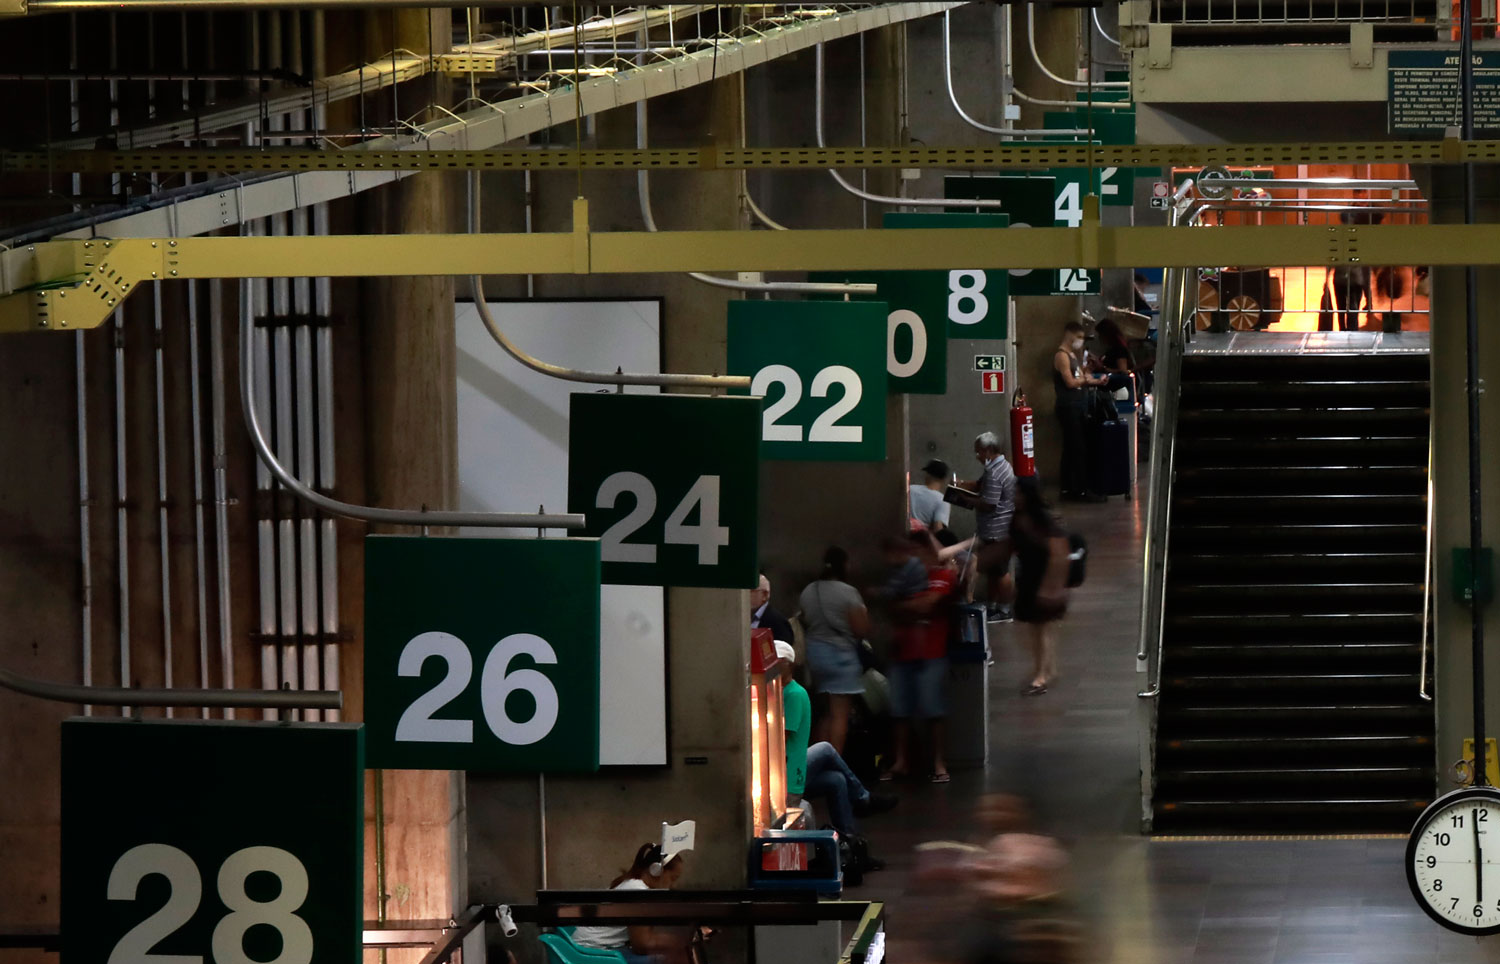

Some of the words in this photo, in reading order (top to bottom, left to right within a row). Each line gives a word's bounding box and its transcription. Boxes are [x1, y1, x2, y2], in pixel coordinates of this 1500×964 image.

[1444, 55, 1483, 65] ATEÃO
[947, 269, 989, 325] 8
[750, 364, 863, 443] 22
[595, 471, 731, 567] 24
[394, 631, 560, 746] 26
[1450, 815, 1464, 828] 11
[1472, 808, 1488, 822] 2
[1433, 832, 1451, 847] 10
[1426, 855, 1437, 869] 9
[1433, 878, 1443, 892] 8
[1450, 897, 1460, 911] 7
[1473, 904, 1483, 918] 6
